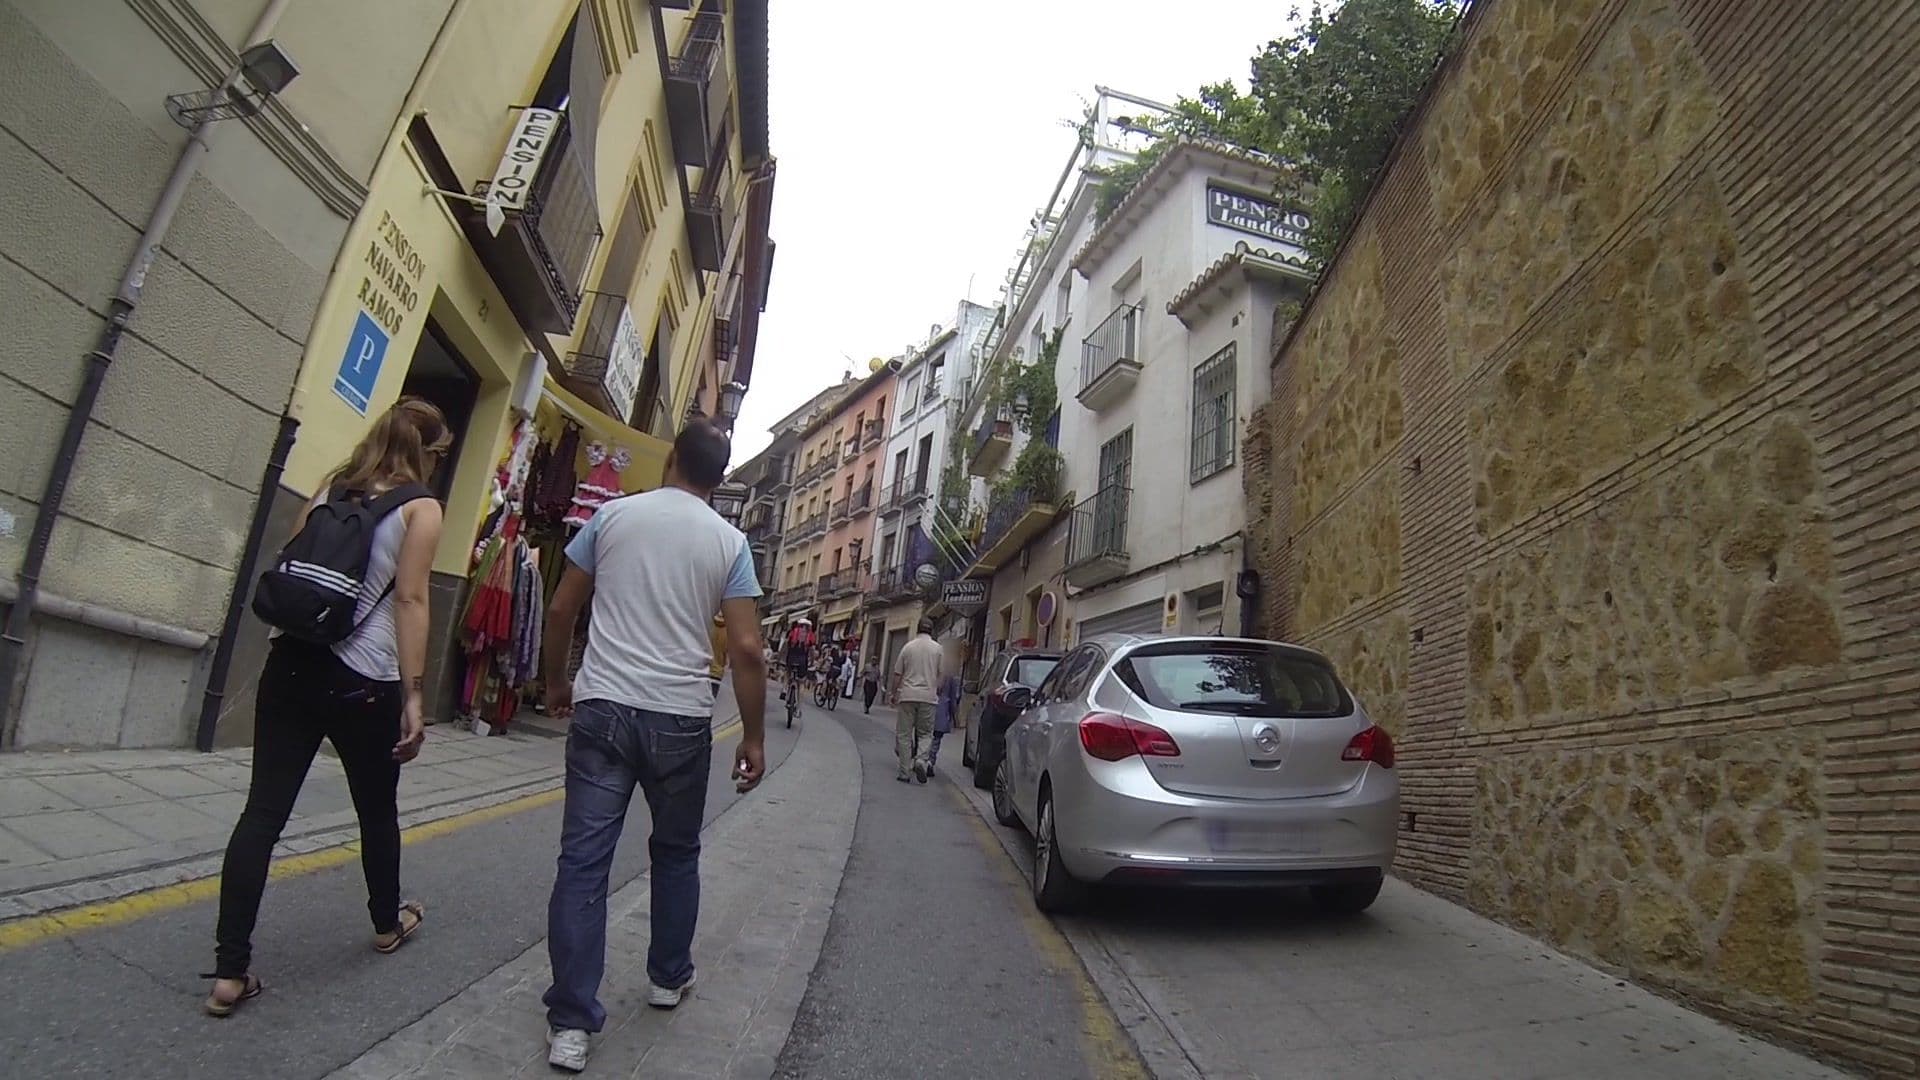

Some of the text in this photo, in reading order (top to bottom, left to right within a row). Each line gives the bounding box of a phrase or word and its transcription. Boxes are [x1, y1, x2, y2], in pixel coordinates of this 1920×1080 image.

[494, 112, 553, 204] PENSION
[1214, 191, 1311, 231] PENSIO
[1221, 207, 1317, 244] Landázu
[377, 209, 426, 283] PENSION
[364, 240, 418, 313] NAVARRO
[357, 276, 403, 336] RAMOS
[352, 333, 375, 374] P
[944, 583, 985, 594] PENSION
